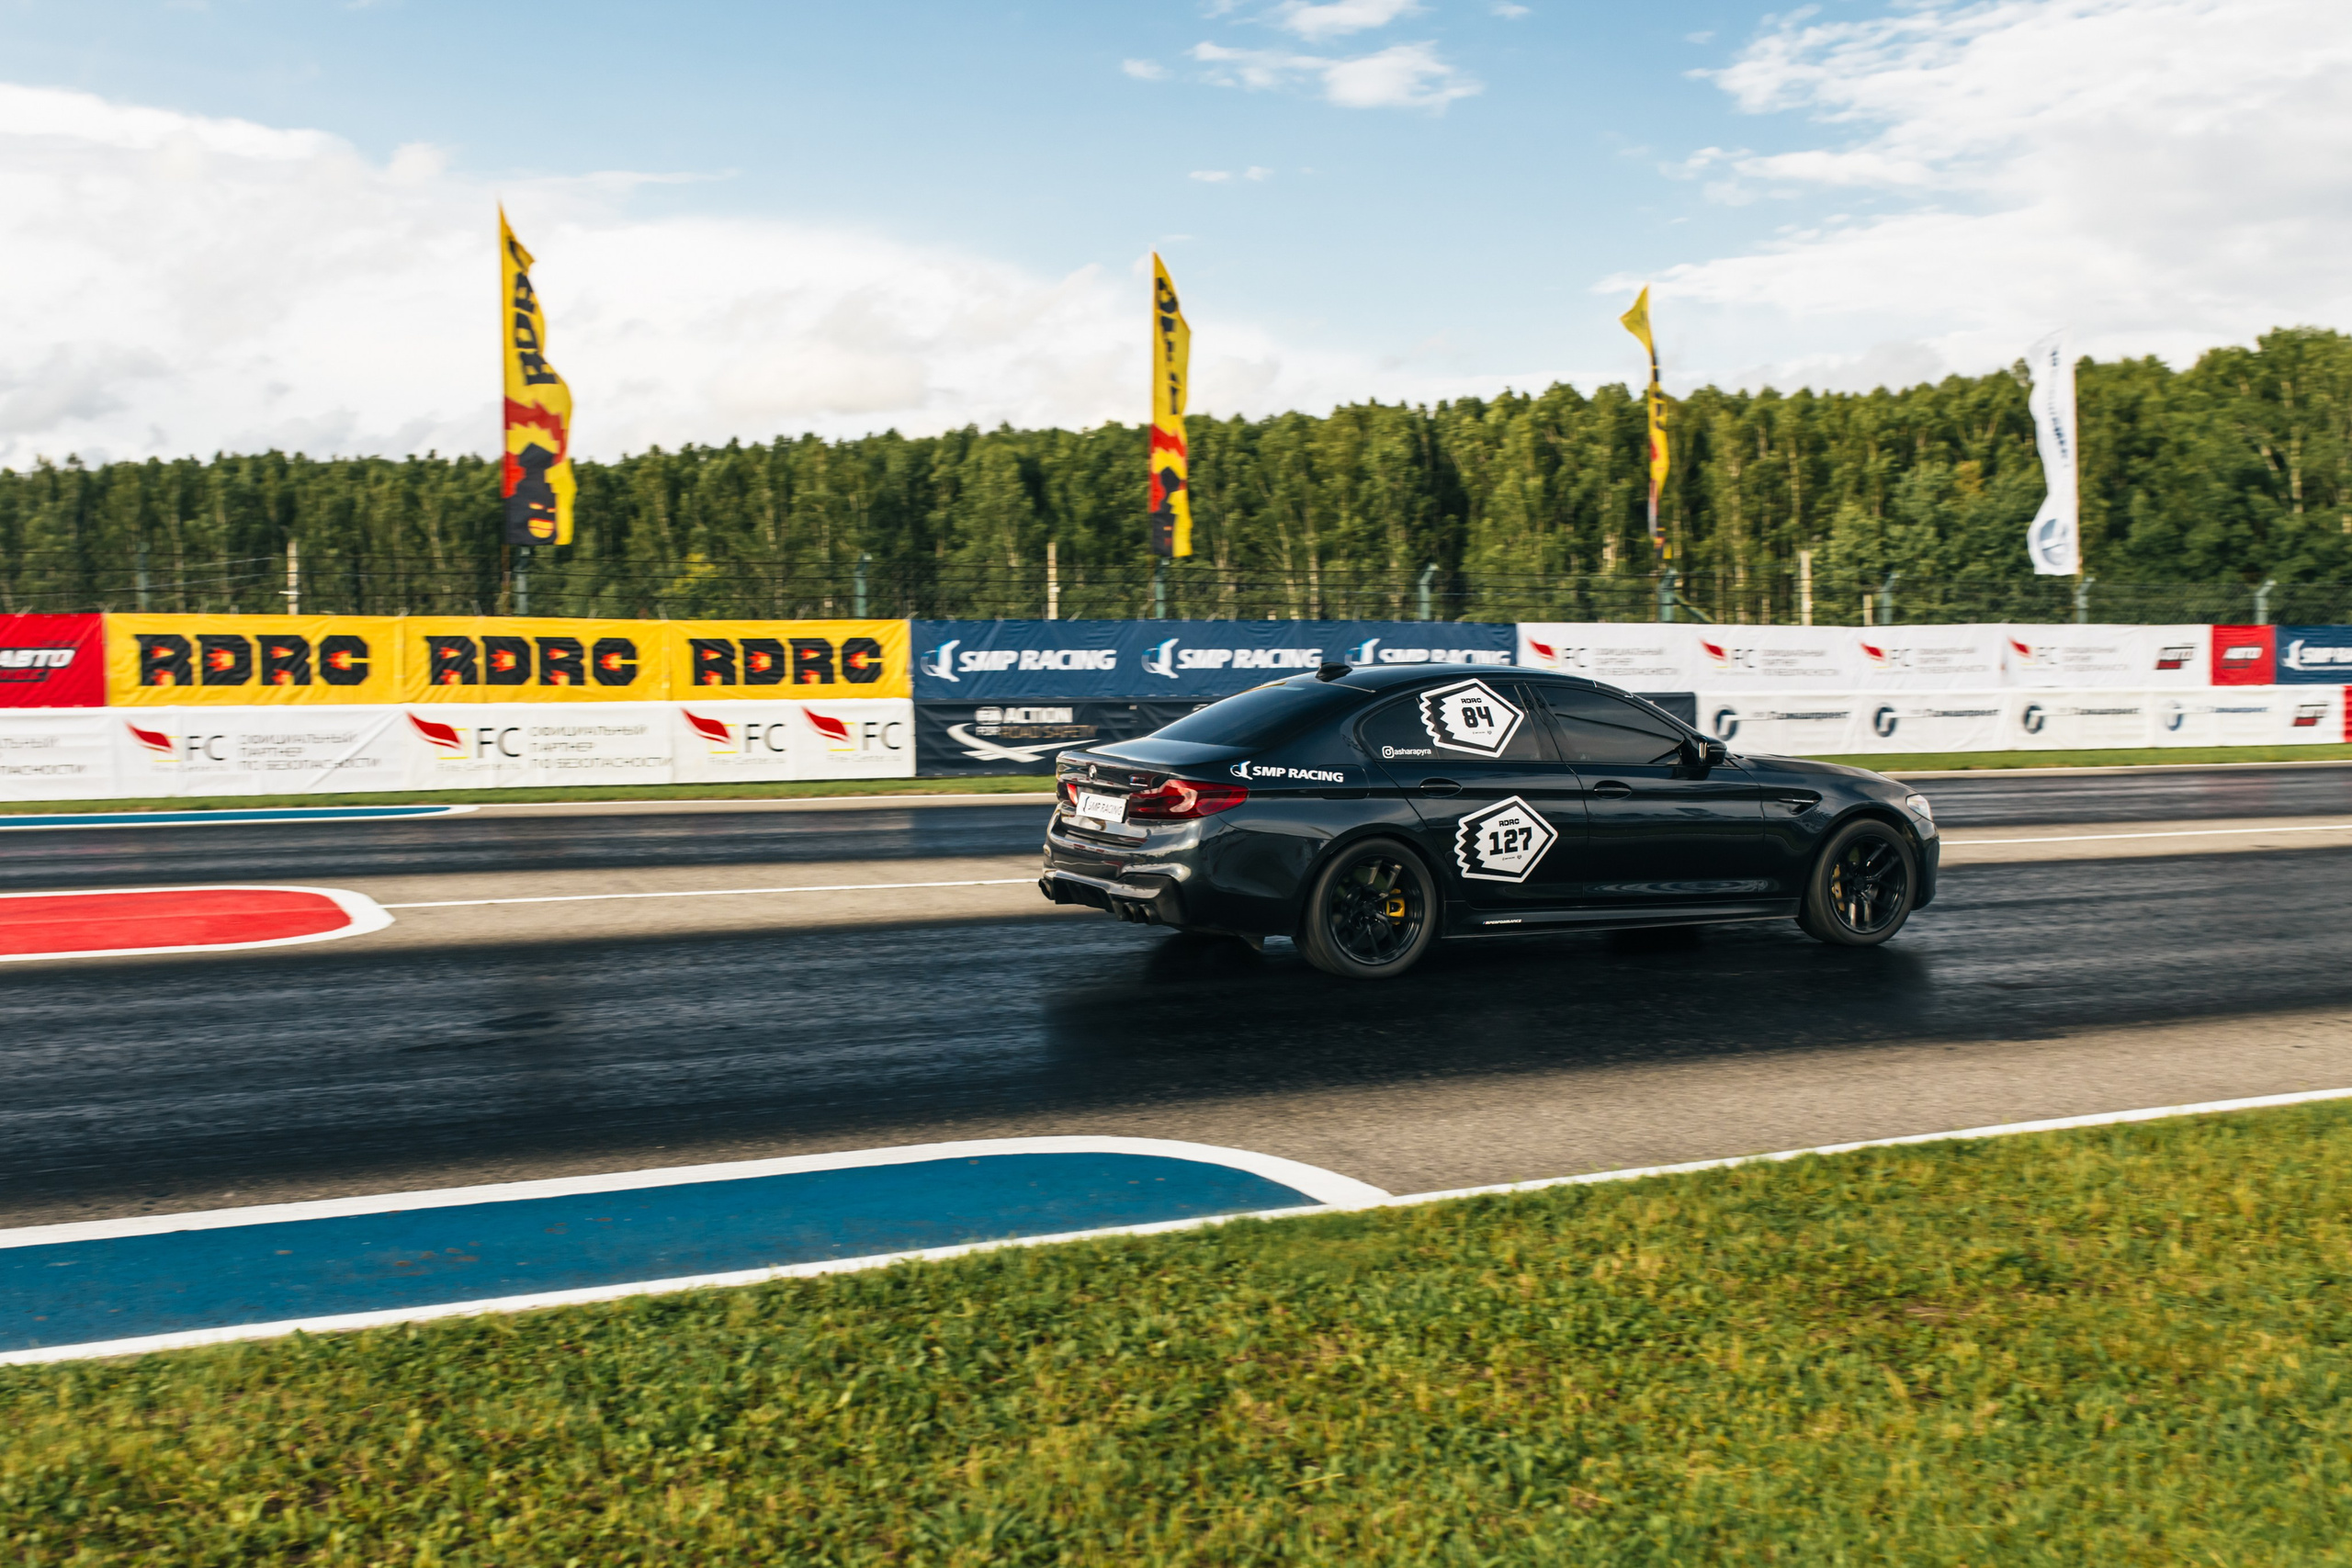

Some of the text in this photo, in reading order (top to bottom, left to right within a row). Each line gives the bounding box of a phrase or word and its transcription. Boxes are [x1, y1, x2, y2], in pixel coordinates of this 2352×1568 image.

[134, 634, 370, 685] RDRC
[424, 636, 638, 686] RDRC
[688, 637, 882, 685] RDRC
[957, 649, 1117, 671] SMP RACING
[1177, 649, 1324, 669] SMP RACING
[1461, 706, 1495, 728] 84
[186, 734, 227, 761] FC
[476, 727, 522, 759] FC
[744, 723, 787, 753] FC
[861, 721, 904, 750] FC
[1394, 748, 1431, 756] asharapyra
[1252, 766, 1344, 783] SMP RACING
[1498, 818, 1520, 827] RDRC
[1489, 827, 1532, 855] 127
